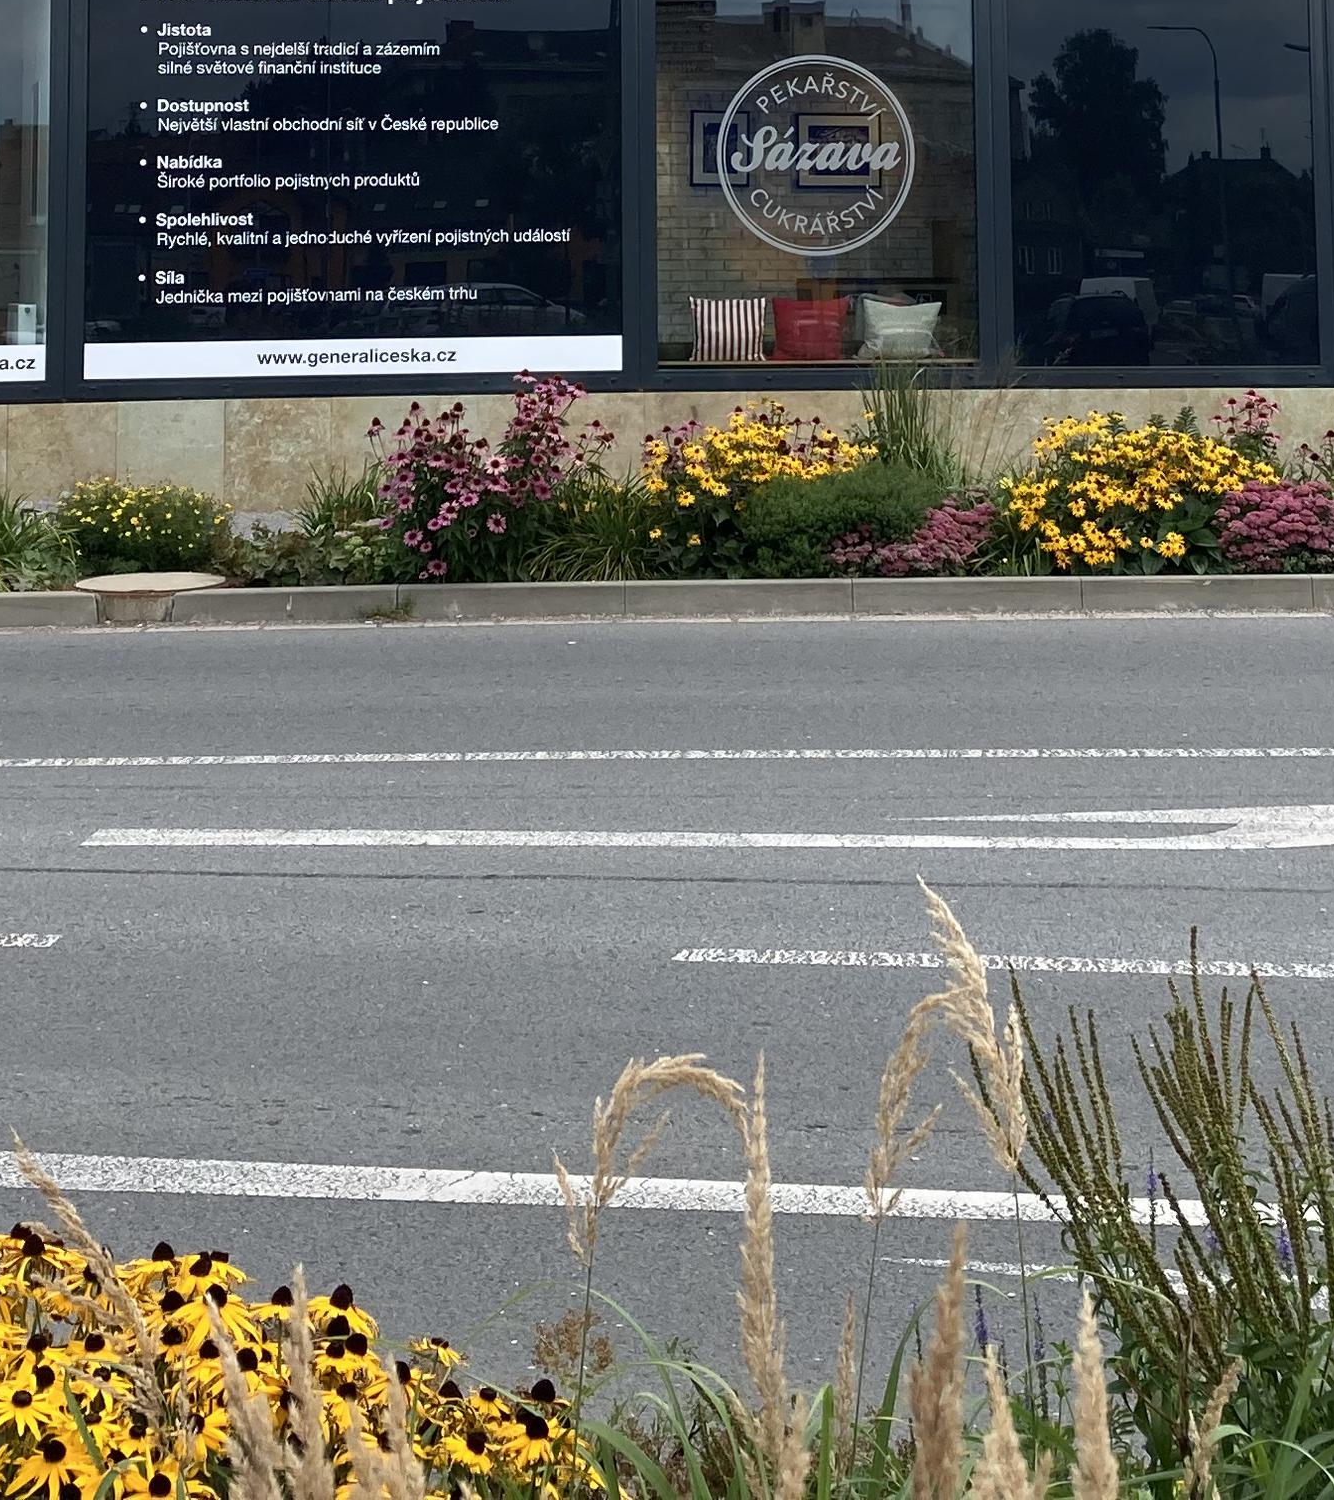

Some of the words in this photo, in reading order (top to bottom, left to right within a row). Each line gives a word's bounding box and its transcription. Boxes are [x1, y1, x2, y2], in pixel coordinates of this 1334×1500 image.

[156, 23, 212, 37] Jistota
[158, 41, 237, 59] Pojišťovna
[240, 44, 250, 56] s
[253, 41, 310, 59] nejdelší
[313, 41, 360, 56] tradicí
[362, 44, 373, 56] a
[375, 41, 441, 56] zázemím
[157, 60, 193, 75] silné
[196, 59, 255, 75] světové
[257, 60, 317, 75] finanční
[320, 60, 382, 75] instituce
[755, 72, 888, 121] PEKAŘSTVÍ
[156, 98, 250, 116] Dostupnost
[157, 116, 218, 134] Největší
[221, 116, 270, 132] vlastní
[272, 116, 343, 132] obchodní
[346, 116, 366, 131] síť
[368, 119, 378, 131] v
[380, 115, 428, 131] České
[431, 117, 499, 134] republice
[730, 125, 903, 172] Sázava
[156, 154, 223, 170] Nabídka
[157, 171, 206, 189] Široké
[209, 173, 271, 192] portfolio
[275, 173, 351, 191] pojistných
[354, 171, 420, 190] produktů
[750, 184, 884, 236] CUKRÁŘSTVÍ
[155, 212, 254, 230] Spolehlivost
[156, 231, 212, 250] Rychlé,
[216, 230, 269, 246] kvalitní
[272, 233, 282, 245] a
[284, 229, 373, 248] jednoduché
[375, 228, 432, 247] vyřízení
[435, 228, 509, 247] pojistných
[513, 227, 571, 243] událostí
[154, 270, 185, 285] Síla
[155, 288, 224, 305] Jednička
[227, 289, 263, 303] mezi
[267, 287, 361, 306] pojišťovnami
[365, 290, 384, 302] na
[387, 286, 445, 301] českém
[448, 285, 478, 300] trhu
[257, 348, 456, 368] www.generaliceska.cz
